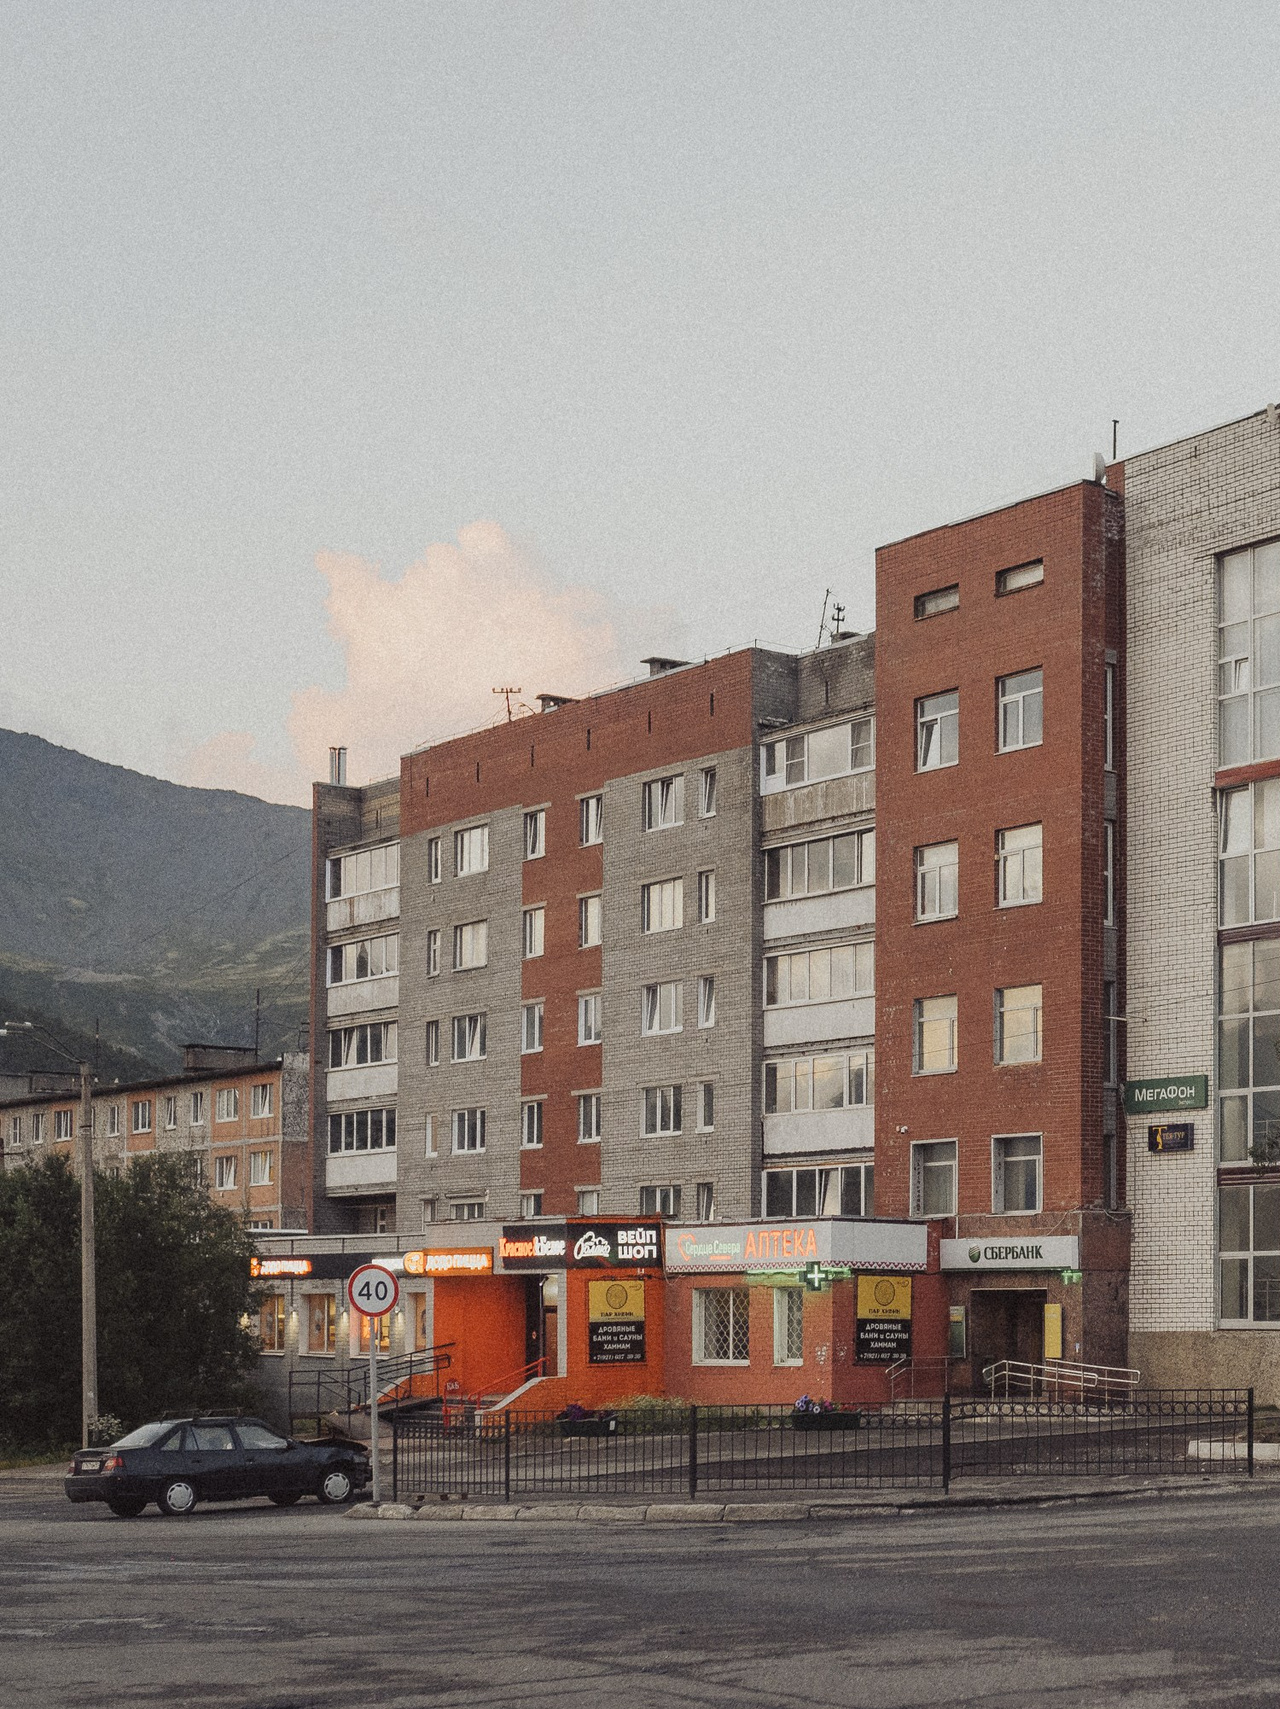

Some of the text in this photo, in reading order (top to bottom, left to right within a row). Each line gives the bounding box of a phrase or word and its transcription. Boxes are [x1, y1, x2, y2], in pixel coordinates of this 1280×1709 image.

[617, 1228, 657, 1244] ВЕЙП
[685, 1240, 740, 1256] Сердце Севера
[744, 1228, 818, 1259] АПТЕКА
[618, 1245, 657, 1259] ШОП
[984, 1245, 1043, 1260] СБЕРБАНК
[358, 1281, 388, 1301] 40
[598, 1325, 636, 1333] ДРОВЯНЫЕ
[865, 1323, 902, 1331] ДРОВЯНЫЕ
[592, 1334, 612, 1342] БАНИ
[619, 1333, 643, 1341] САУНЫ
[885, 1332, 909, 1340] САУНЫ
